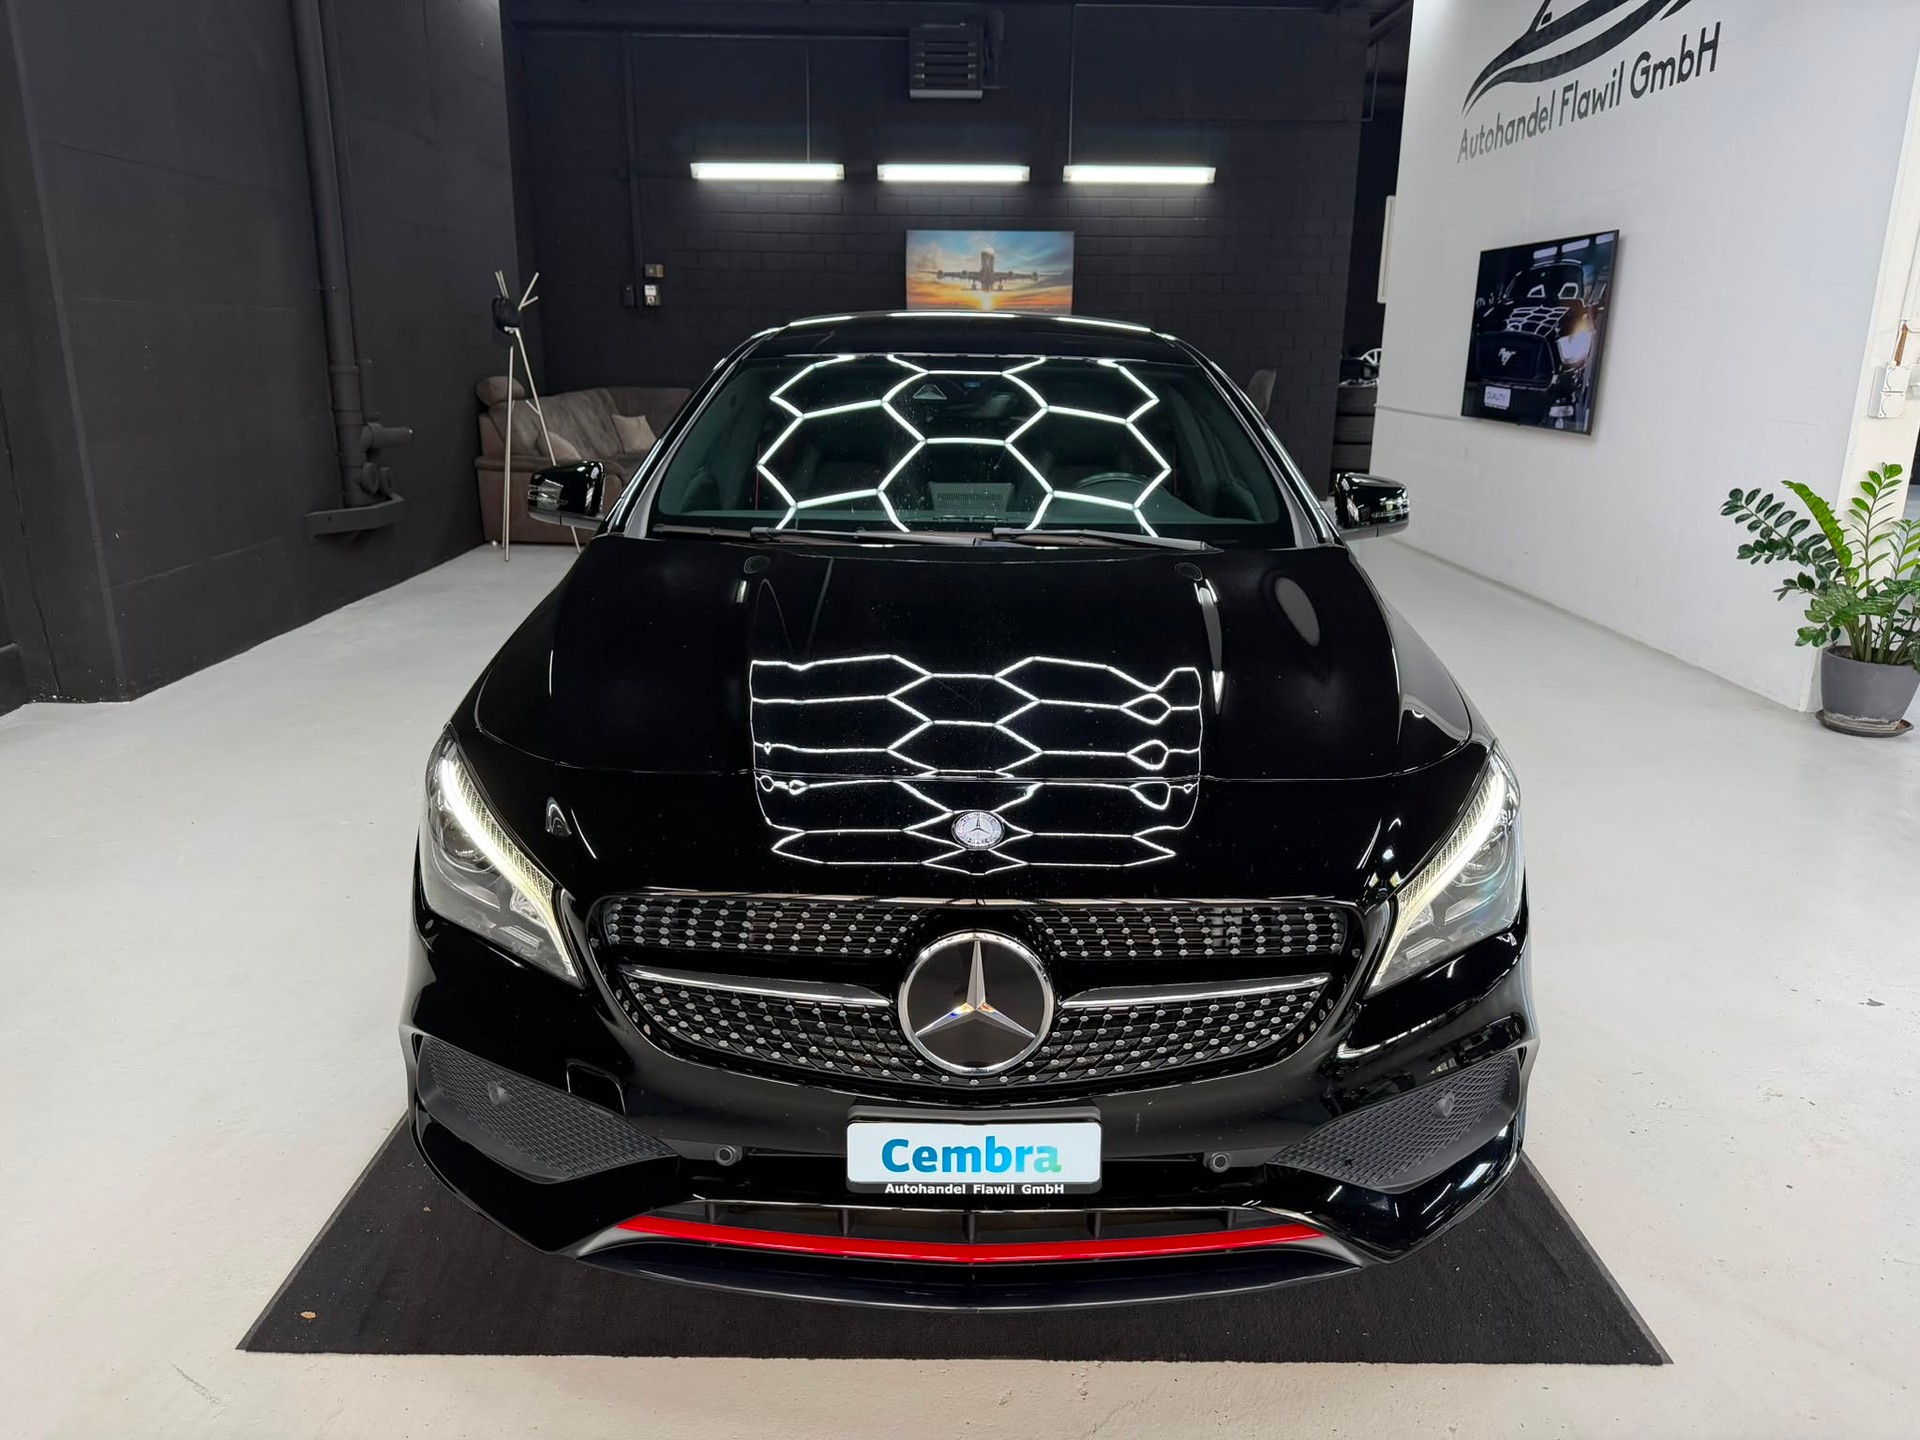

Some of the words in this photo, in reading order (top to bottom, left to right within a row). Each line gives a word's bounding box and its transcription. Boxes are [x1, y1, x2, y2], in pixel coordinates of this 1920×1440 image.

[1457, 90, 1555, 163] Autohandel
[1559, 60, 1625, 126] Flawil
[1630, 21, 1721, 99] GmbH
[882, 1136, 1062, 1173] Cembra
[885, 1184, 966, 1194] Autohandel
[973, 1184, 1015, 1194] Flawil
[1022, 1184, 1064, 1194] GmbH
